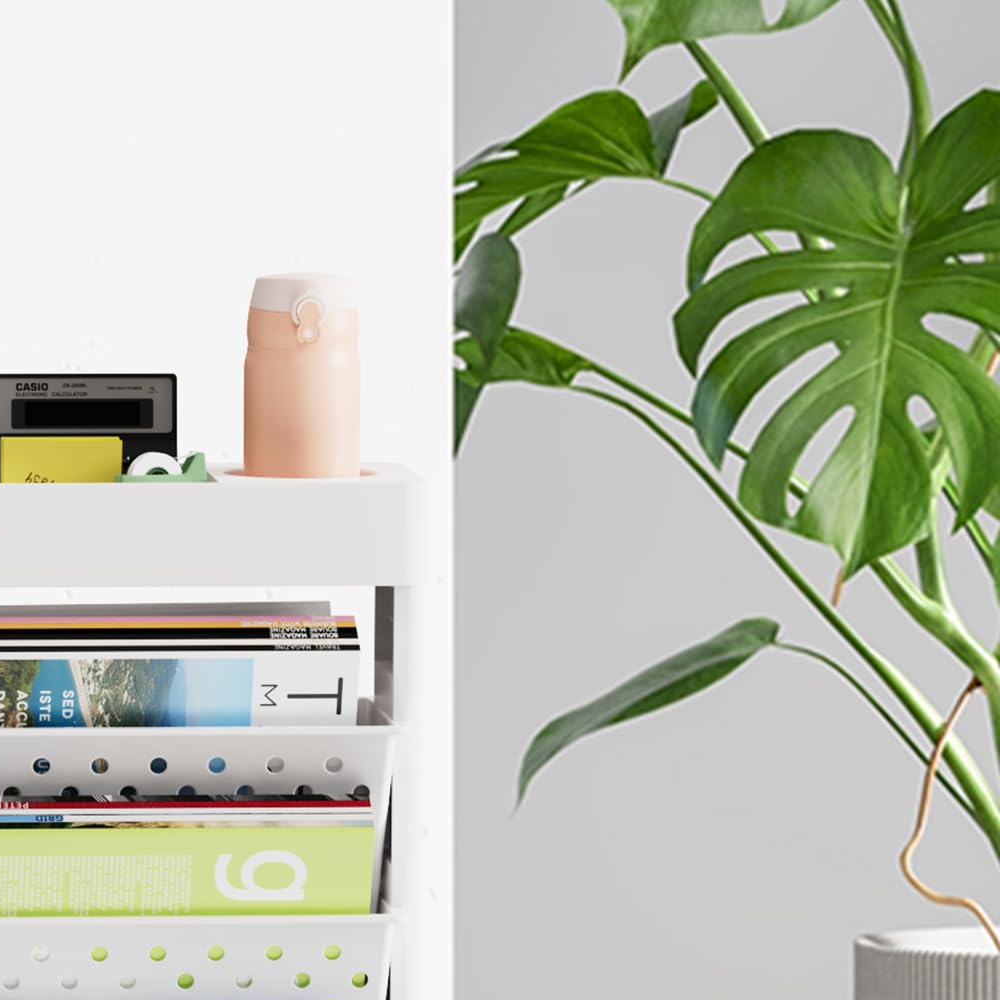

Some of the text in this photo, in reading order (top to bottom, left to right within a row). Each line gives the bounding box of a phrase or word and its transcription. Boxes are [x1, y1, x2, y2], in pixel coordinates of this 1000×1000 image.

[16, 382, 49, 391] CASIO
[39, 690, 52, 722] ISTE
[61, 689, 75, 719] SED
[261, 684, 278, 706] M
[287, 677, 343, 716] T
[214, 849, 309, 903] g
